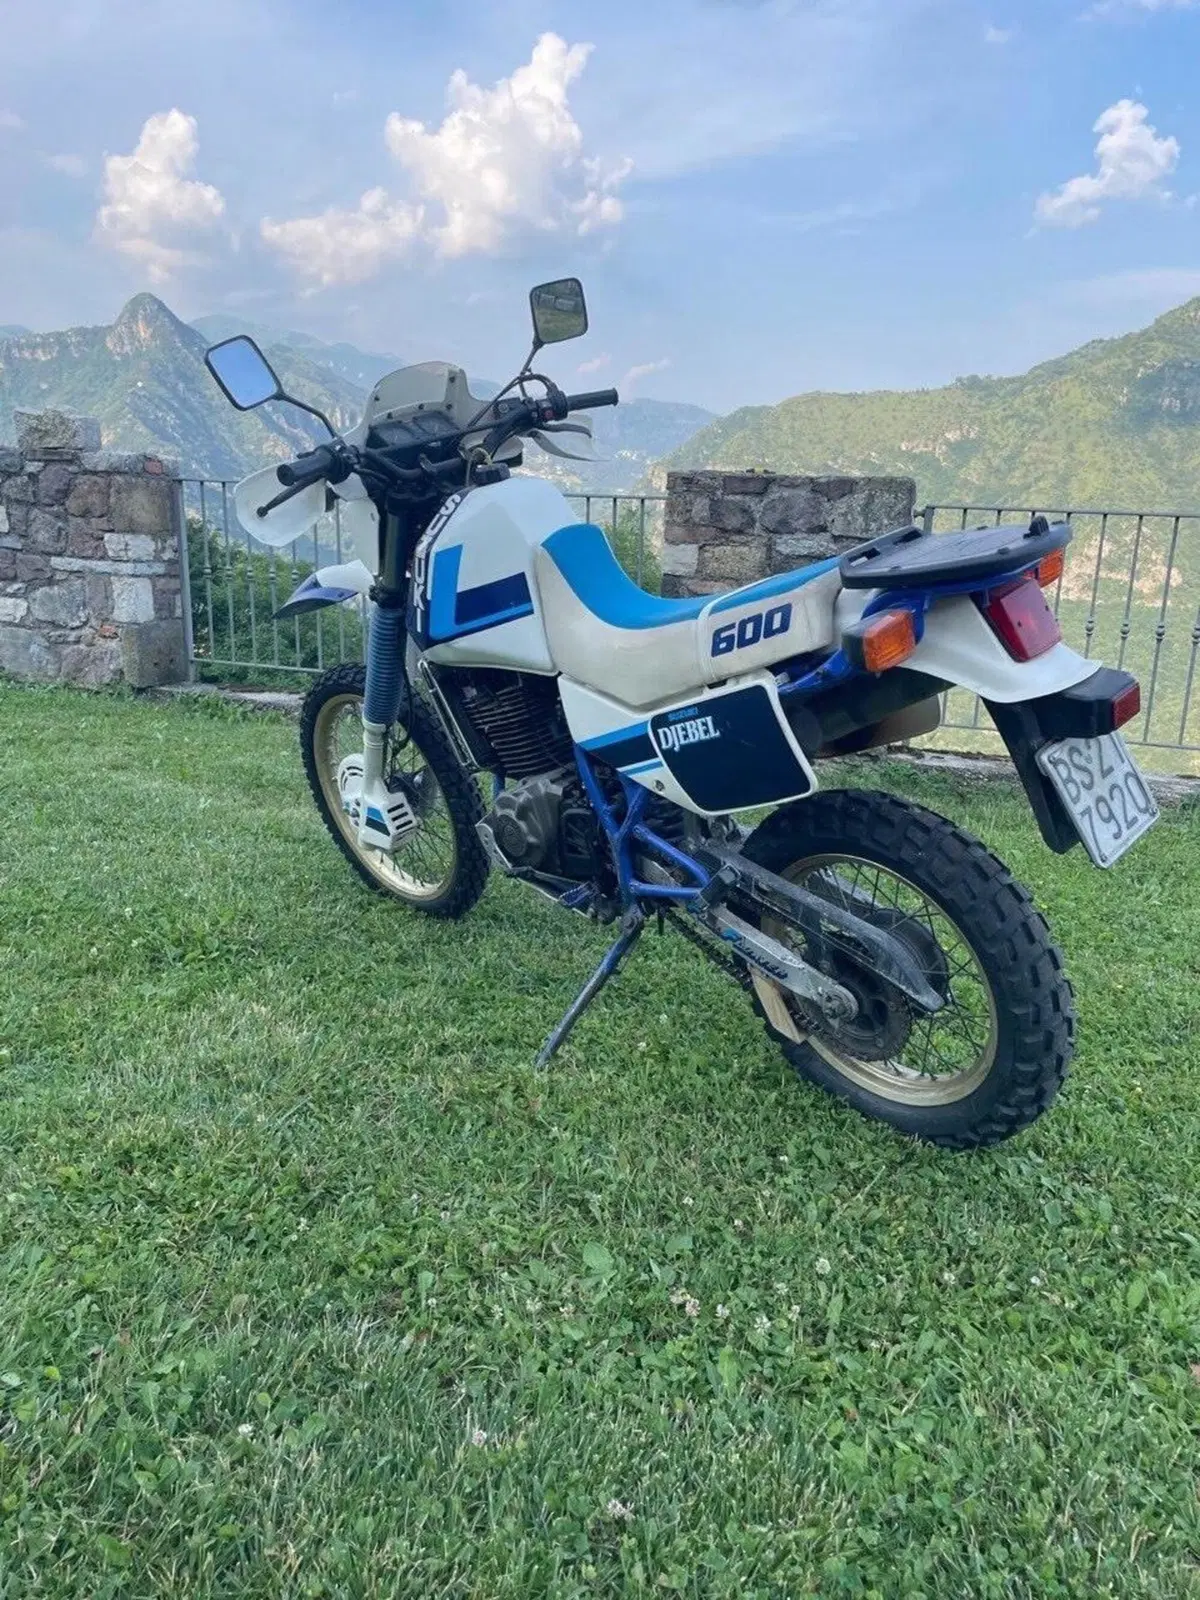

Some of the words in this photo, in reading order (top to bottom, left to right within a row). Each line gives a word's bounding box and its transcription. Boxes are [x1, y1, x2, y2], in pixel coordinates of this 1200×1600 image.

[413, 494, 462, 633] SUZUKI
[711, 603, 792, 658] 600
[657, 716, 720, 752] DJEBEL
[1079, 771, 1152, 860] 7920
